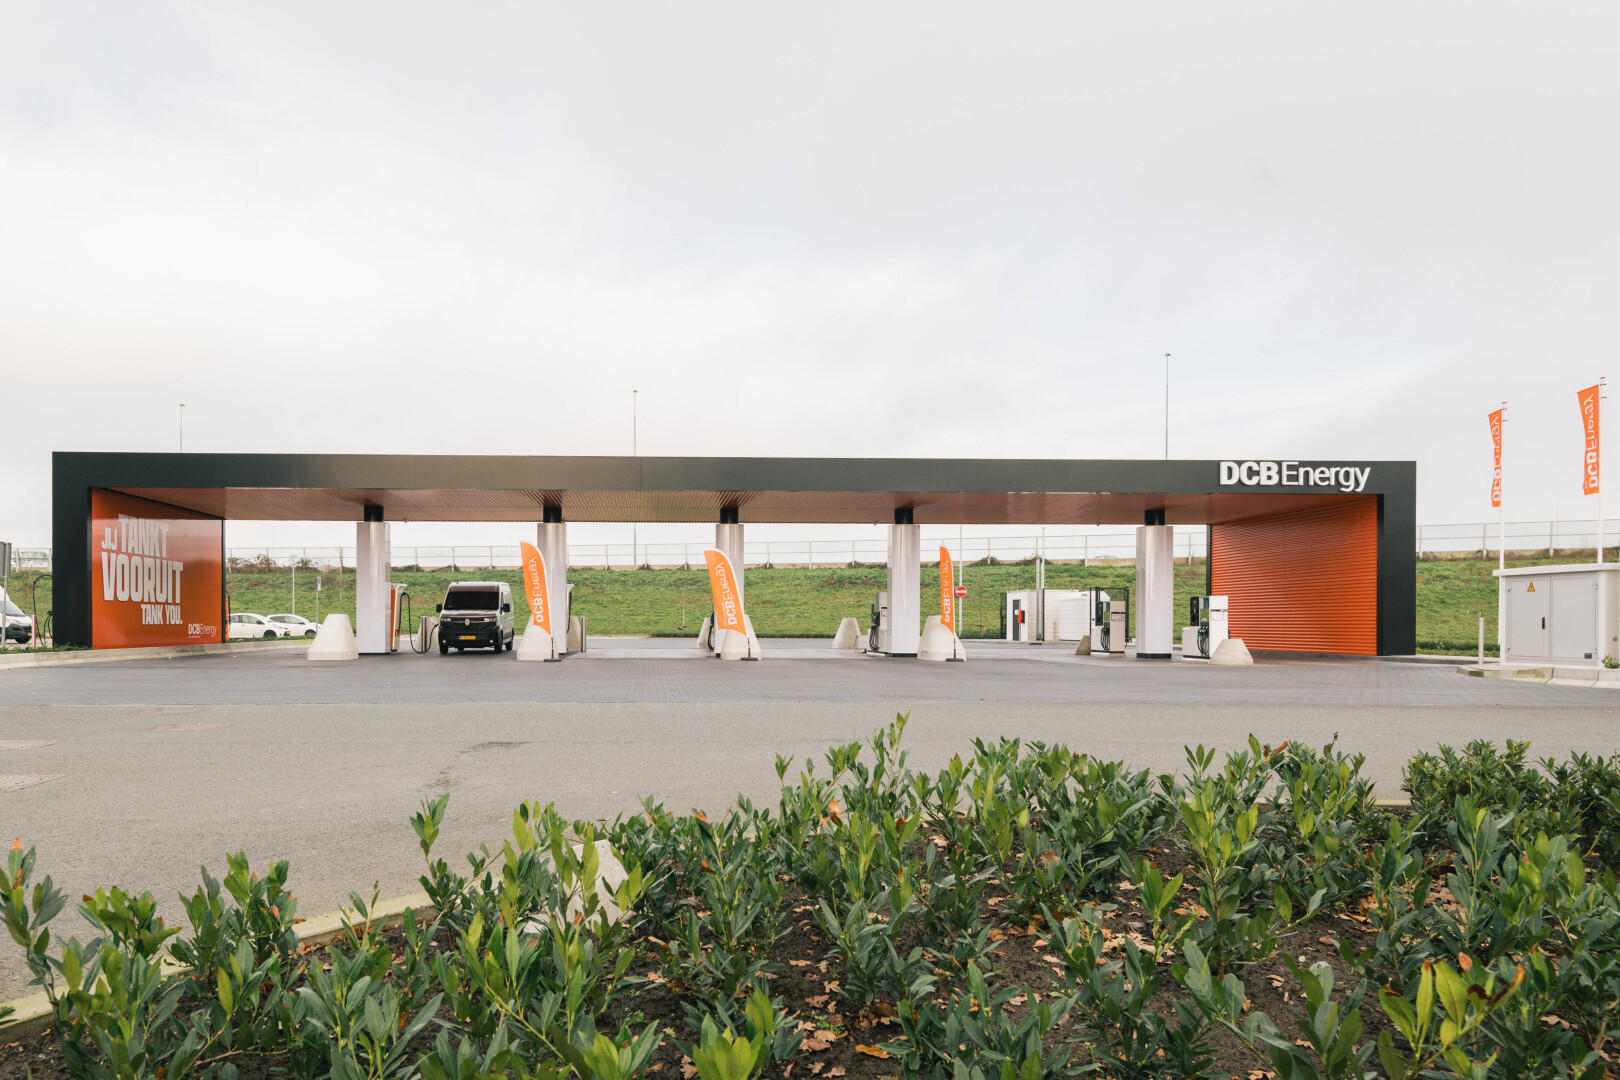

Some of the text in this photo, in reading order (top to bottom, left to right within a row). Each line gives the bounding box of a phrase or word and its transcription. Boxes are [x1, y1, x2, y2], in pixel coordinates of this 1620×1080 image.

[1219, 461, 1371, 492] DCBEnergy
[118, 514, 169, 558] TANKT
[101, 551, 184, 604] VOORUIT
[141, 604, 183, 625] TANK YOU.
